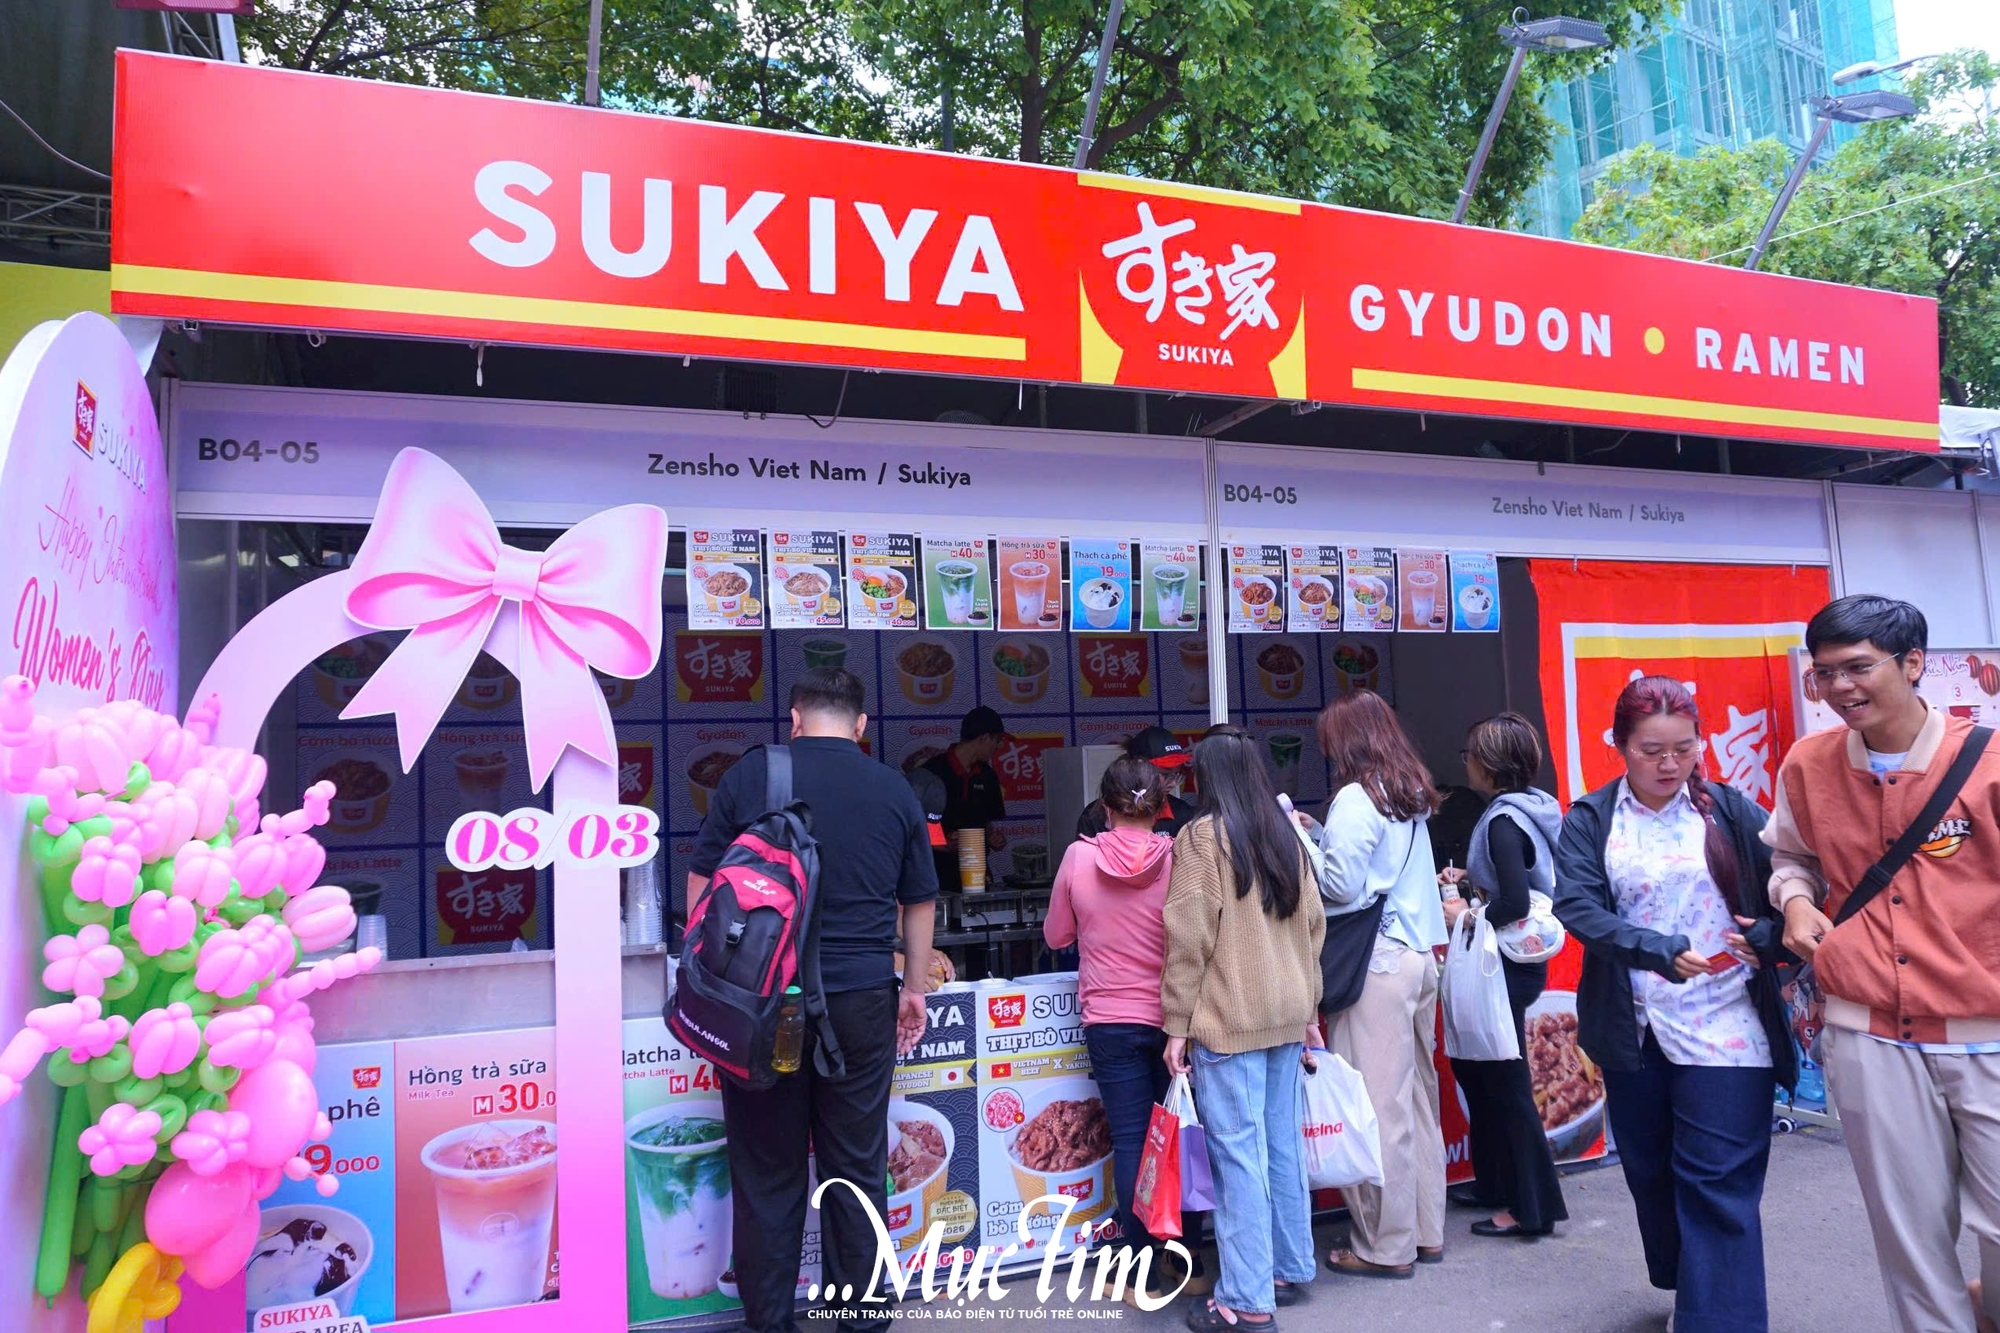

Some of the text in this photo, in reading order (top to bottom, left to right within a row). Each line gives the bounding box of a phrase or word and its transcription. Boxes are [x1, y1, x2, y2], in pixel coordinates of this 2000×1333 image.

[469, 160, 1025, 312] SUKIYA
[1102, 201, 1280, 341] すき家
[1349, 283, 1866, 387] GYUDON RAMEN
[1158, 343, 1235, 366] SUKIYA
[97, 421, 146, 495] SUKIYA
[198, 437, 320, 465] B04-05
[648, 453, 972, 489] Zensho Viet Nam / Sukiya
[1223, 483, 1298, 505] B04-05
[1492, 496, 1547, 516] Zensho
[1551, 499, 1584, 517] Viet
[1588, 502, 1623, 519] Nam
[1640, 504, 1685, 524] Sukiya
[38, 475, 93, 592] Happy
[711, 533, 755, 543] SUKIYA
[791, 535, 834, 544] SUKIYA
[869, 537, 910, 547] SUKIYA
[926, 540, 971, 548] Matcha latte
[1001, 541, 1019, 549] Hồng
[1021, 541, 1031, 549] trà
[1144, 544, 1168, 552] Matcha
[1246, 547, 1279, 556] SUKIYA
[1304, 548, 1336, 557] SUKIYA
[1359, 550, 1390, 559] SUKIYA
[1111, 552, 1128, 561] phê
[128, 630, 165, 711] Day
[684, 638, 753, 683] すき家
[1085, 640, 1141, 680] すき家
[1954, 686, 1962, 698] 3
[696, 729, 746, 742] Gyudon
[456, 812, 649, 864] 08/03
[446, 873, 525, 921] すき家
[920, 1040, 966, 1058] NAM
[986, 1024, 1087, 1053] THỊT BÒ VIỆ
[409, 1059, 547, 1086] Hồng trà sữa
[1013, 1057, 1050, 1068] VIETNAM
[1065, 1060, 1093, 1070] YAKIN
[623, 1068, 675, 1080] tcha Latte
[896, 1080, 930, 1090] GYUDON
[408, 1089, 454, 1100] Milk Tea
[498, 1081, 557, 1113] 30.0
[328, 1096, 381, 1125] phê
[300, 1144, 380, 1176] 9.000
[986, 1200, 1025, 1217] Cơm
[987, 1219, 1009, 1237] bò
[260, 1304, 334, 1329] SUKIYA
